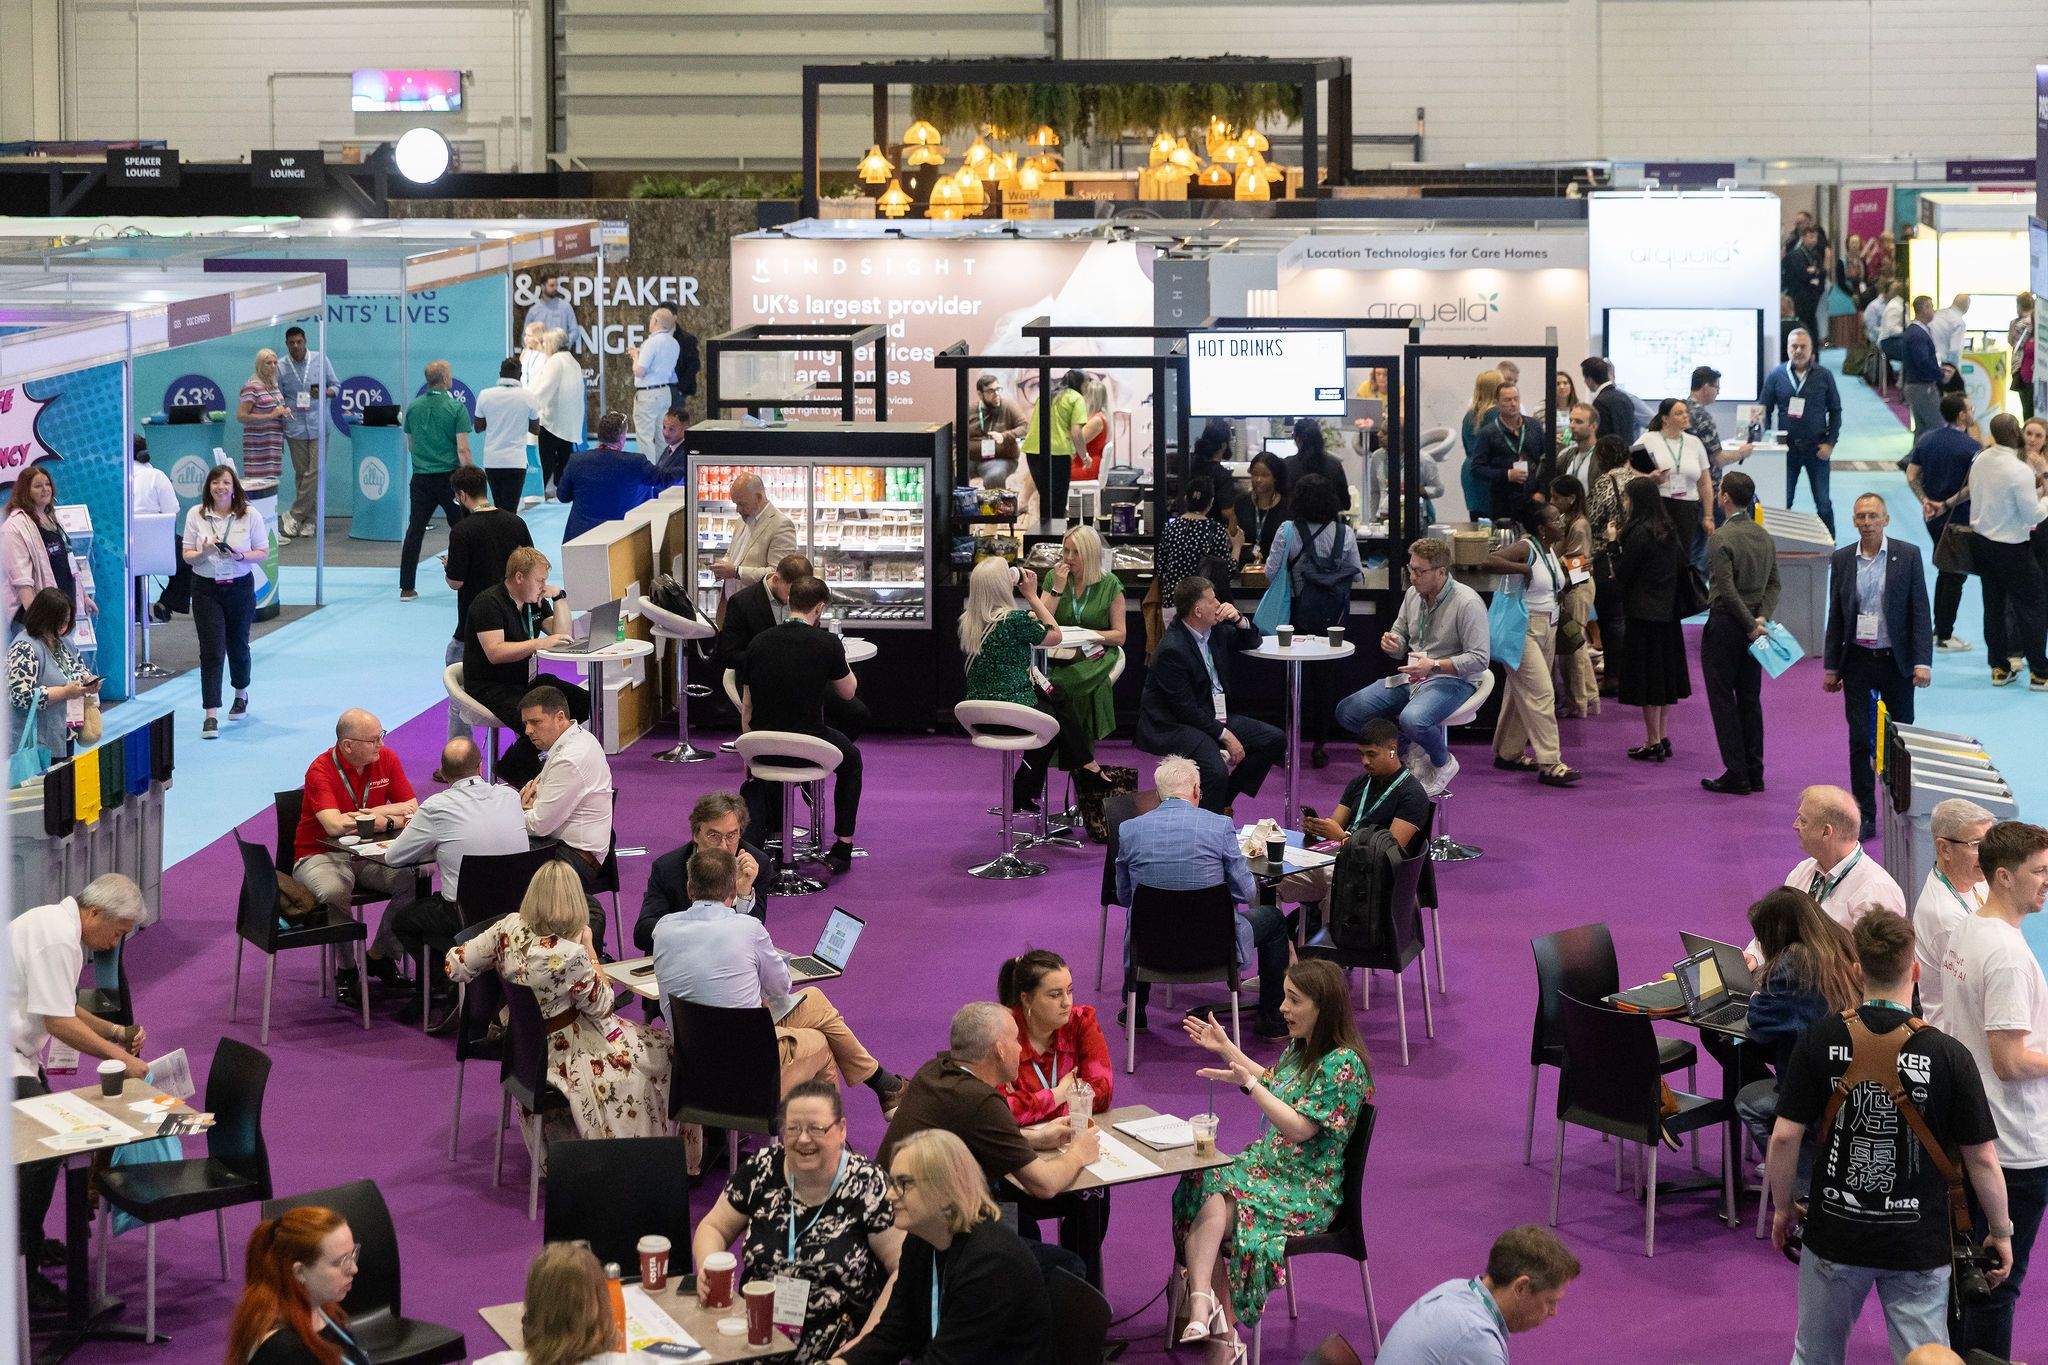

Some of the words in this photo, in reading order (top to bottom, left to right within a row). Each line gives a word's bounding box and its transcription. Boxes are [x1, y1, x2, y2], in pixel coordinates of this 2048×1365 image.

[124, 156, 162, 166] SPEAKER
[280, 157, 296, 166] VIP
[125, 168, 161, 178] LOUNGE
[270, 168, 306, 178] LOUNGE
[1307, 248, 1361, 259] Location
[1366, 248, 1446, 261] Technologies
[1449, 248, 1468, 259] for
[1471, 248, 1500, 259] Care
[1504, 248, 1549, 259] Homes
[755, 258, 976, 275] KINDSIGHT
[556, 276, 701, 307] SPEAKER
[805, 293, 882, 320] largest
[887, 294, 982, 320] provider
[1198, 339, 1225, 357] HOT
[1230, 338, 1284, 357] DRINKS
[173, 387, 216, 406] 63%
[341, 388, 383, 411] 50%
[363, 464, 385, 496] ally
[1885, 1195, 1920, 1210] haze
[649, 1256, 657, 1284] COSTA
